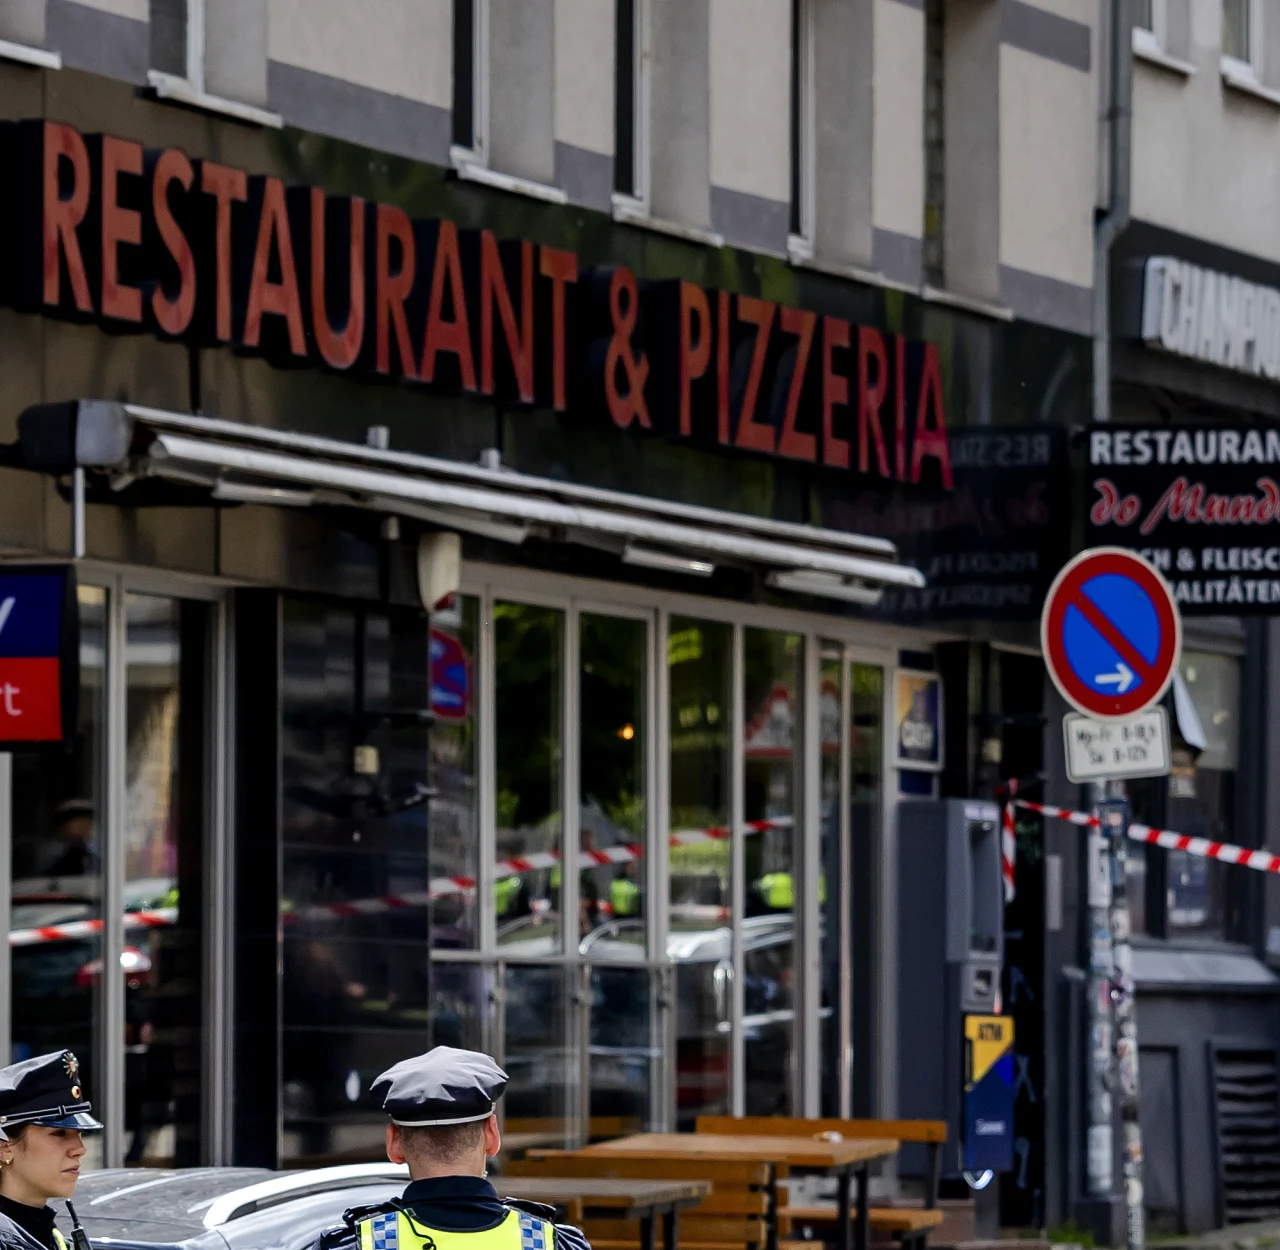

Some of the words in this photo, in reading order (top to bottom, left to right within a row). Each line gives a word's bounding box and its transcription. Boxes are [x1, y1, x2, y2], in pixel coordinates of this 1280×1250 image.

[42, 119, 578, 412] RESTAURANT
[604, 264, 652, 429] &
[679, 279, 954, 489] PIZZERIA
[1090, 477, 1141, 527] do
[1176, 546, 1197, 572] &
